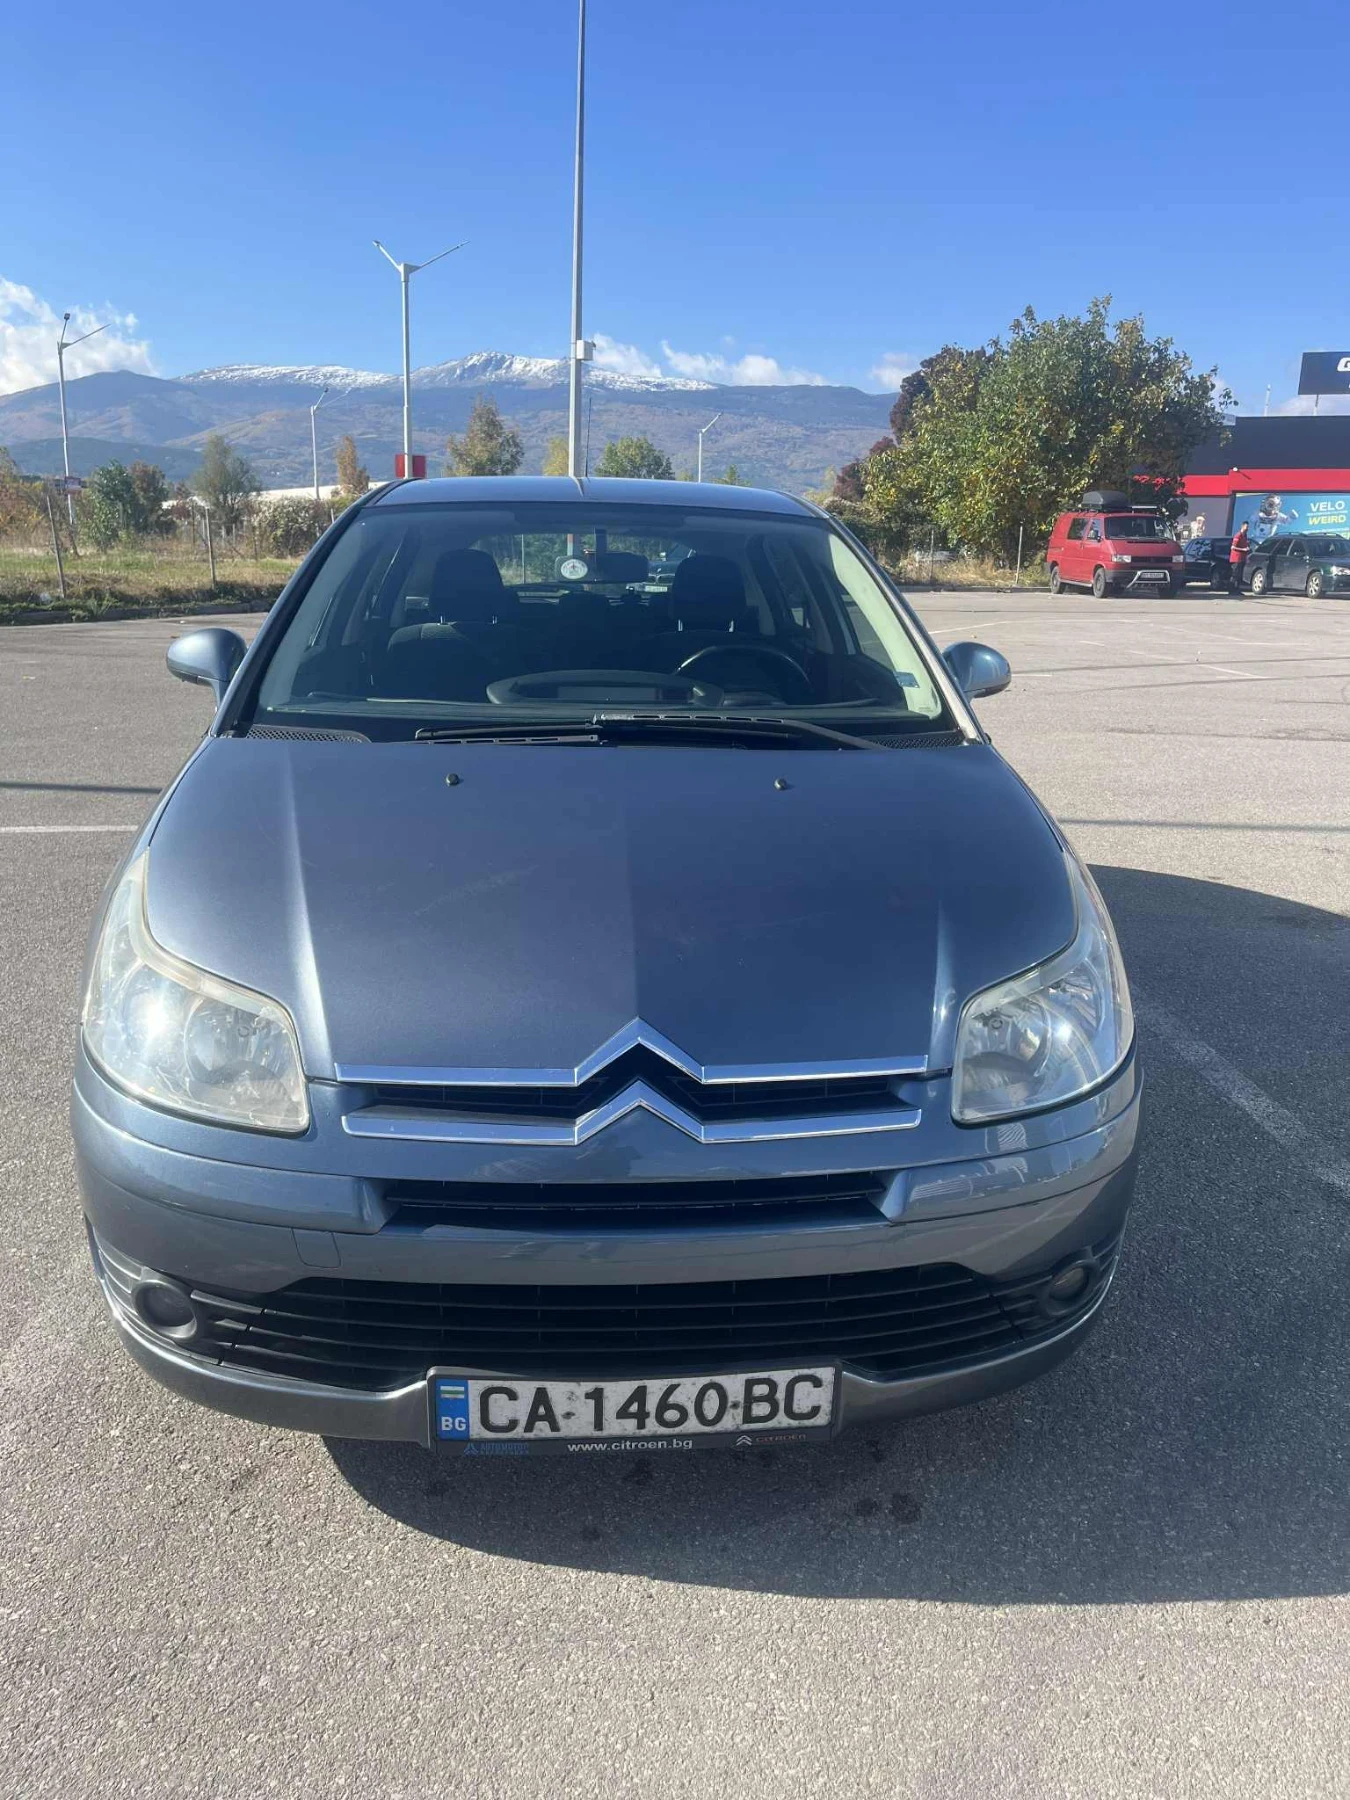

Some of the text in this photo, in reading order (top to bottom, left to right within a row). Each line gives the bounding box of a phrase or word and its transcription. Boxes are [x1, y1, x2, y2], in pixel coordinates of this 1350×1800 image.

[1310, 500, 1345, 512] VELO
[1308, 514, 1346, 525] WEIRD
[479, 1374, 823, 1433] CA 1460 BC
[441, 1416, 467, 1431] BG
[567, 1438, 694, 1452] www.citroen.bg
